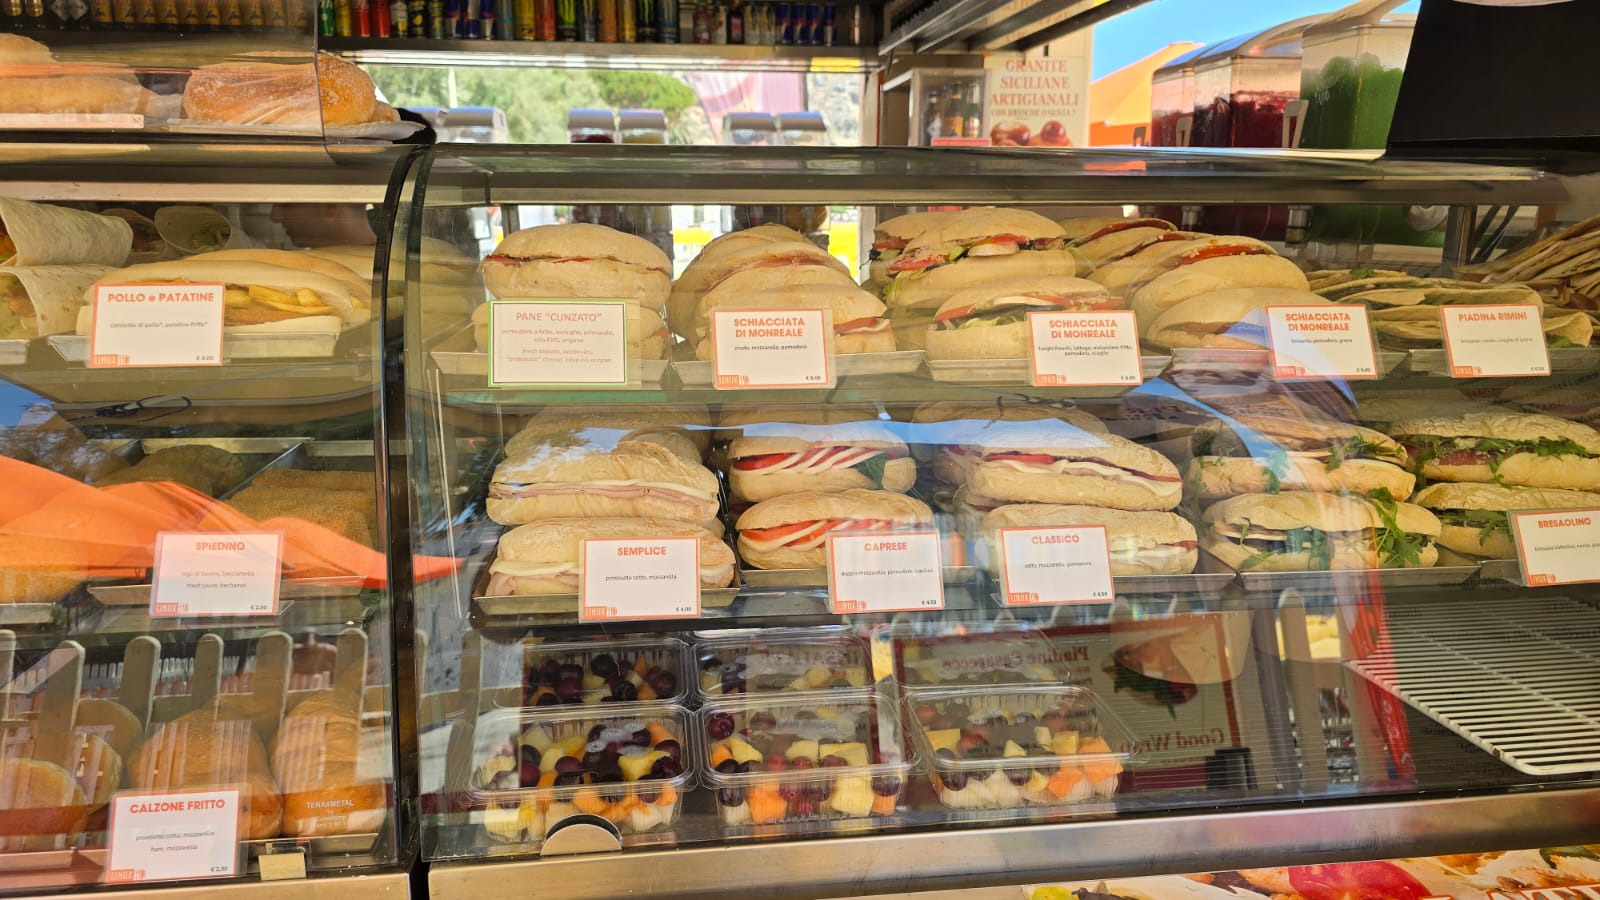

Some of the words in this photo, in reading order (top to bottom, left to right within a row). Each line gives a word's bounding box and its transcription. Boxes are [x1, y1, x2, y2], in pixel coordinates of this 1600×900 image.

[1005, 59, 1067, 72] GRANITE
[1001, 76, 1070, 89] SICILIANE
[992, 93, 1079, 106] ARTIGIANALI
[107, 293, 146, 303] POLLO
[148, 294, 156, 302] e
[159, 292, 214, 302] PATATINE
[516, 312, 543, 321] PANE
[1285, 313, 1351, 321] SCHIACCIATA
[1458, 313, 1496, 321] PIADINA
[1498, 312, 1527, 321] RIMINI
[733, 317, 805, 327] SCHIACCIATA
[1049, 319, 1118, 329] SCHIACCIATA
[1288, 323, 1298, 332] DI
[1300, 323, 1350, 331] MONREALE
[735, 329, 747, 338] DI
[748, 328, 803, 338] MONREALE
[1051, 330, 1061, 339] DI
[1064, 329, 1116, 338] MONREALE
[1537, 517, 1592, 529] BRESAOLINO
[1032, 535, 1080, 544] CLASSICO
[195, 541, 246, 551] SPIEDINO
[864, 542, 908, 551] CAPRESE
[617, 546, 667, 557] SEMPLICE
[129, 801, 185, 814] CALZONE
[187, 799, 225, 811] FRITTO
